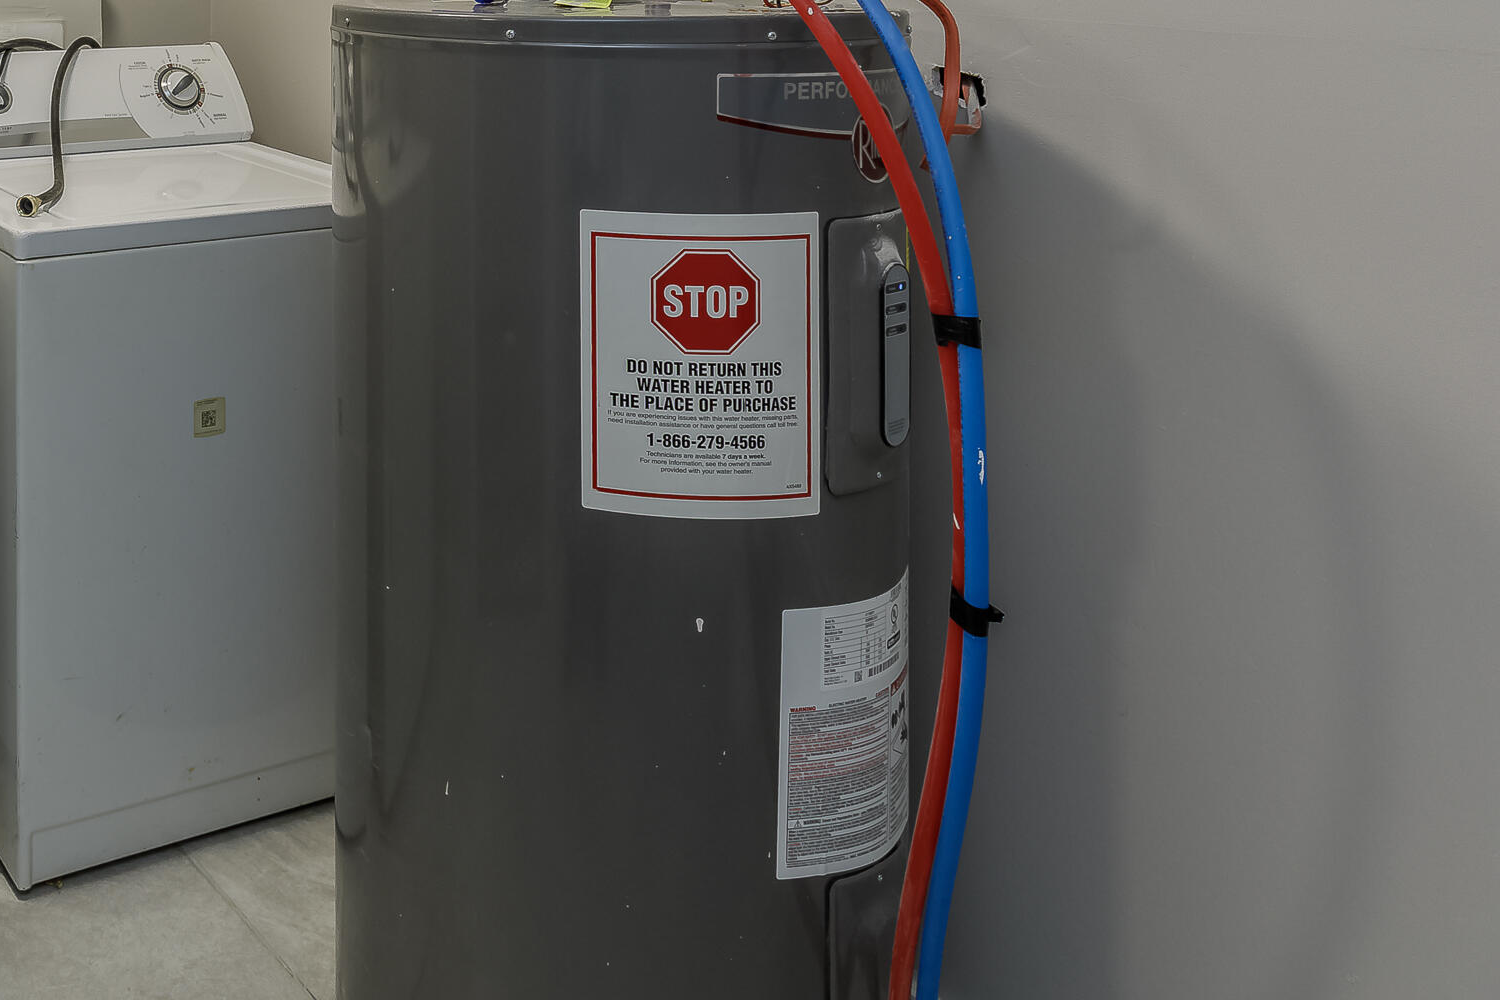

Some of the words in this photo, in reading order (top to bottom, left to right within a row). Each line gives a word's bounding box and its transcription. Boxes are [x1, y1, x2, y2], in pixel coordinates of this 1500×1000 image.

[663, 285, 749, 319] STOP
[626, 359, 648, 374] DO
[653, 360, 683, 376] NOT
[688, 362, 746, 377] RETURN
[751, 361, 782, 377] THIS
[637, 377, 690, 394] WATER
[695, 380, 751, 395] HEATER
[755, 379, 773, 394] TO
[610, 393, 640, 409] THE
[644, 395, 693, 412] PLACE
[699, 398, 718, 413] OF
[723, 396, 796, 412] PURCHASE
[624, 418, 658, 426] installation
[637, 413, 677, 421] experiencing
[646, 433, 766, 450] 1-866-279-4566
[646, 450, 683, 459] Technicians
[727, 453, 743, 461] days
[789, 705, 817, 713] WARNING
